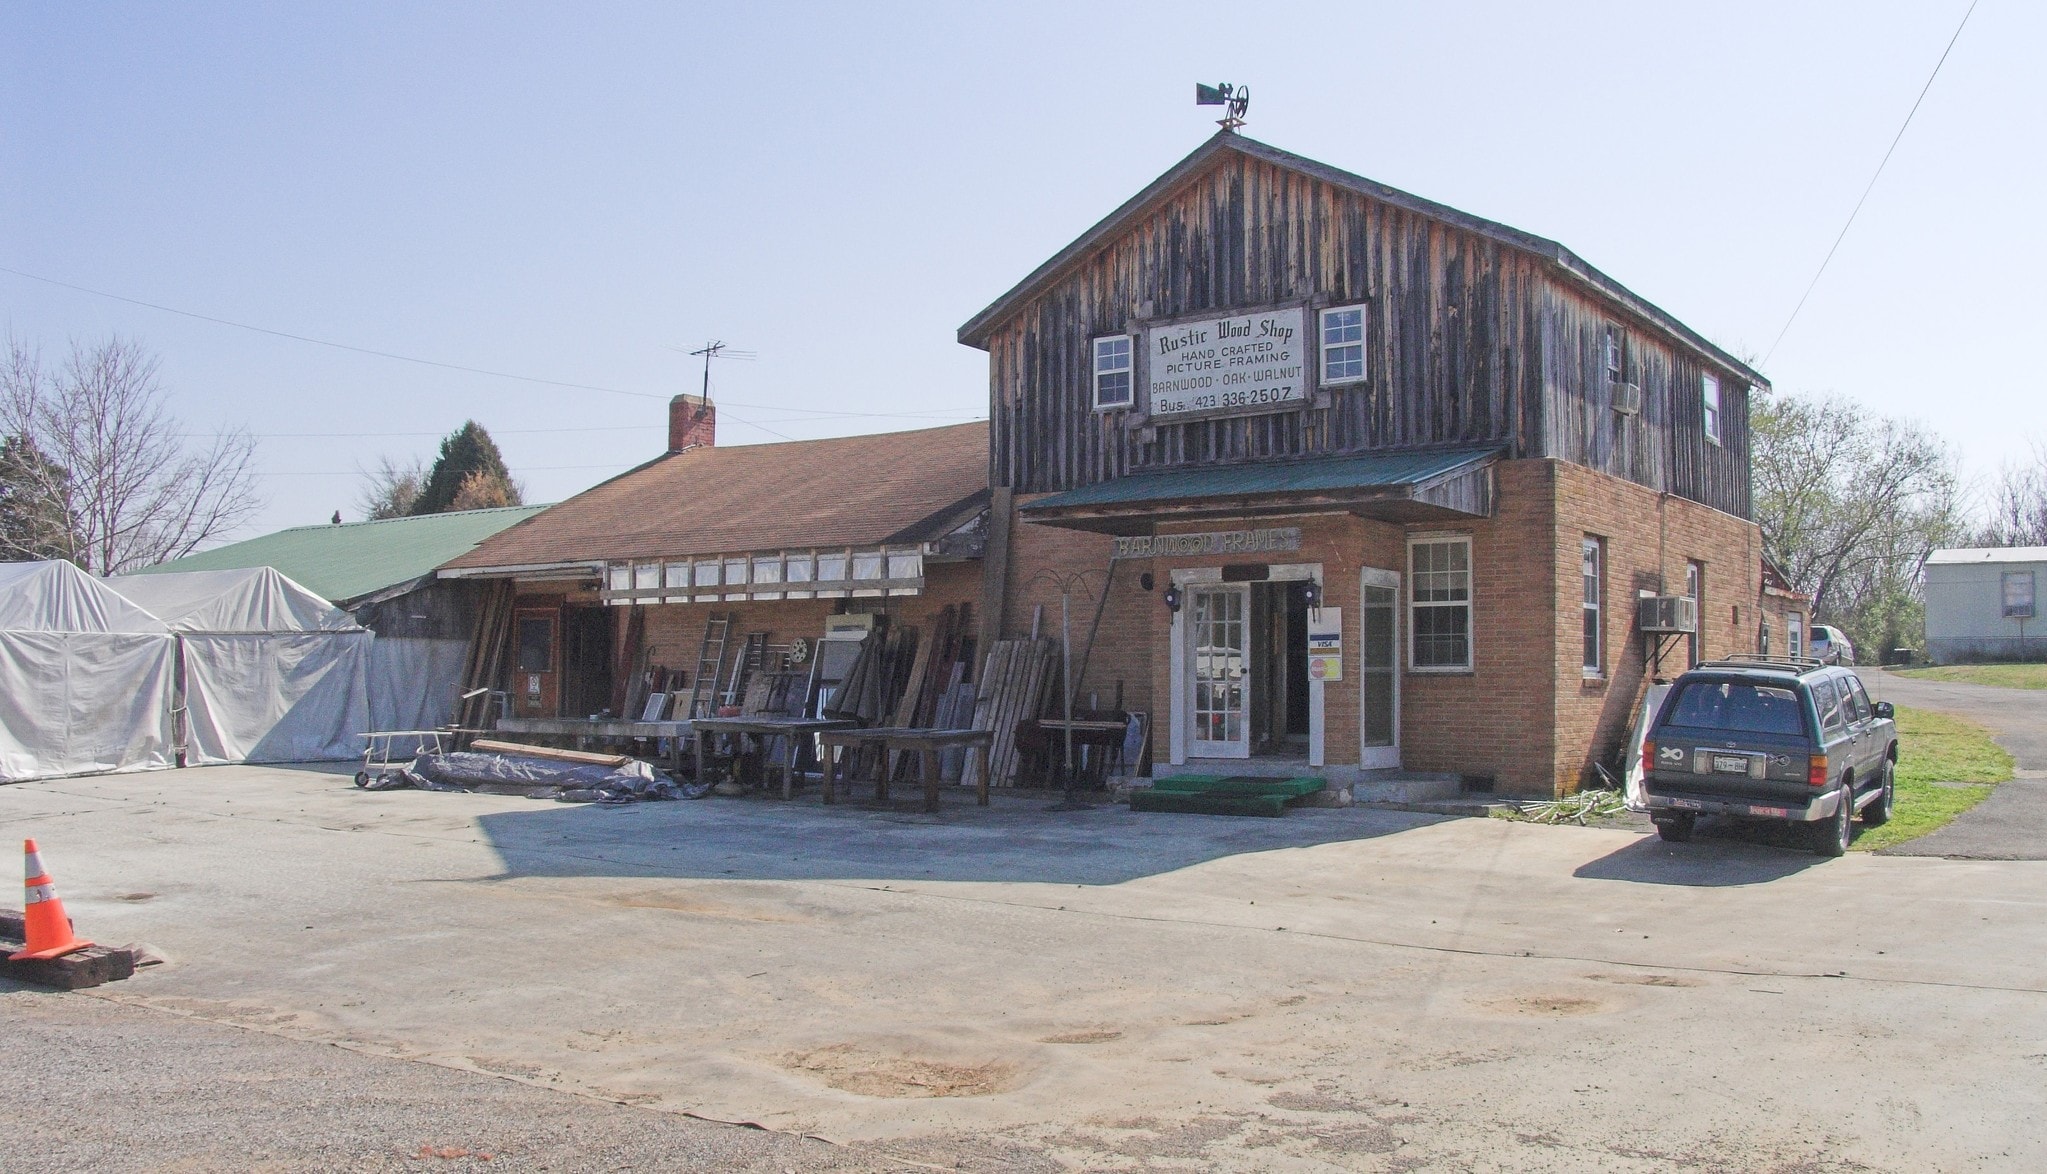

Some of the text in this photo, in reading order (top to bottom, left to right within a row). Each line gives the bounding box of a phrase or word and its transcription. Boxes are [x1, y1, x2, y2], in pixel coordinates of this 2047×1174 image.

[1159, 319, 1293, 355] Rustic Wood Shop
[1166, 351, 1290, 374] PICTURE FRAMING
[1181, 342, 1273, 361] HAND CRAFTED
[1152, 366, 1302, 394] BARNWOOD OAK WALNUT
[1195, 394, 1216, 408] 423
[1222, 386, 1292, 407] 336-2507
[1117, 529, 1289, 555] BARNWOOD FRAMES
[1317, 640, 1333, 648] VISA
